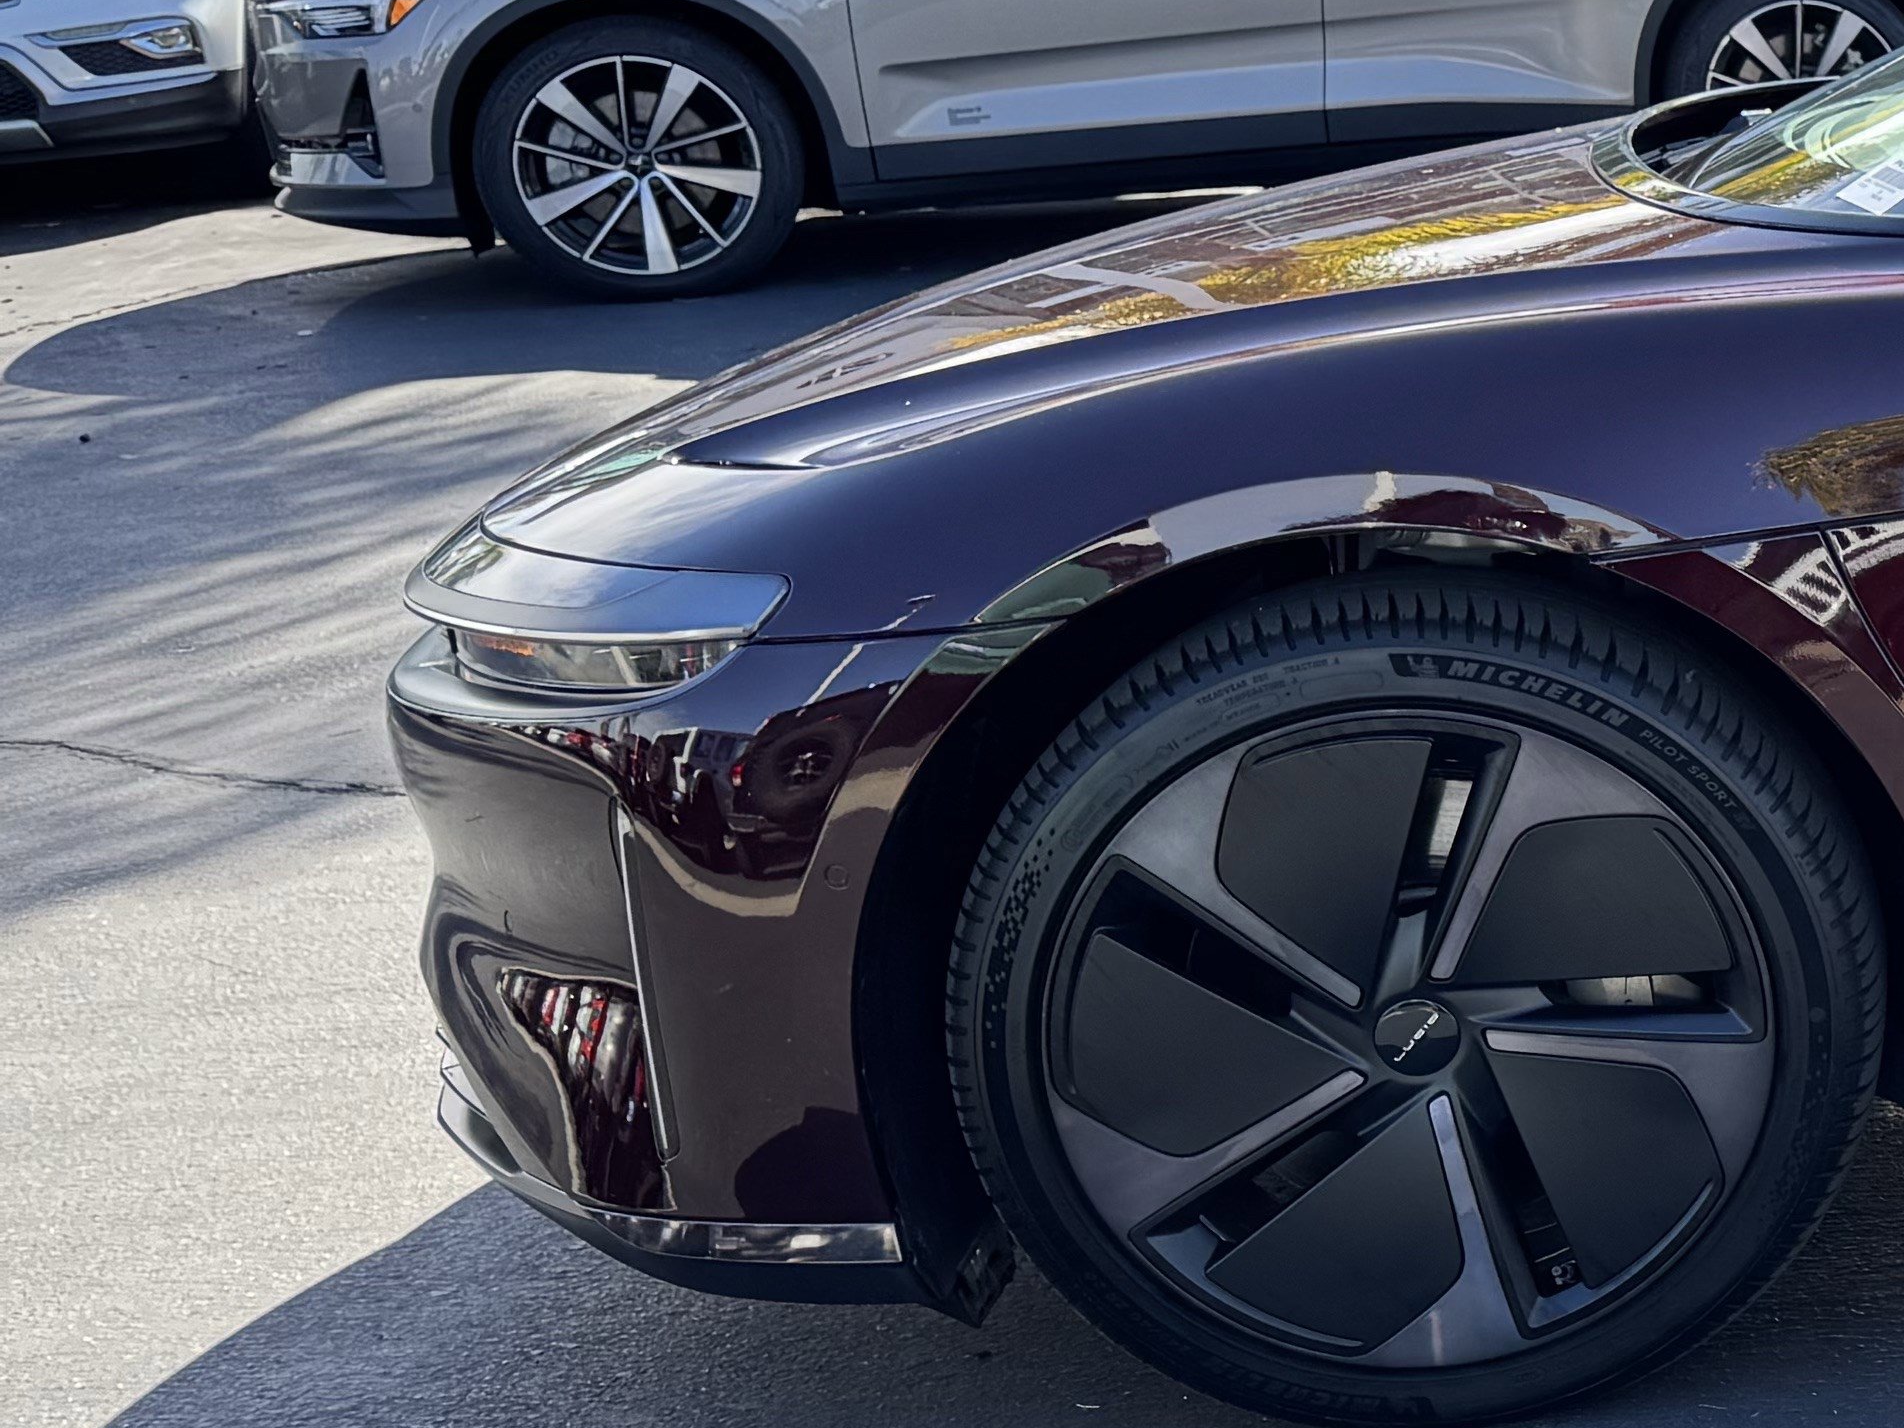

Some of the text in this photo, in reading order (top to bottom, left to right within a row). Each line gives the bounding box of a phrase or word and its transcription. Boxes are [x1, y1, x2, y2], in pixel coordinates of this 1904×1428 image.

[1448, 660, 1738, 810] MICHELIN PILOT SPORT
